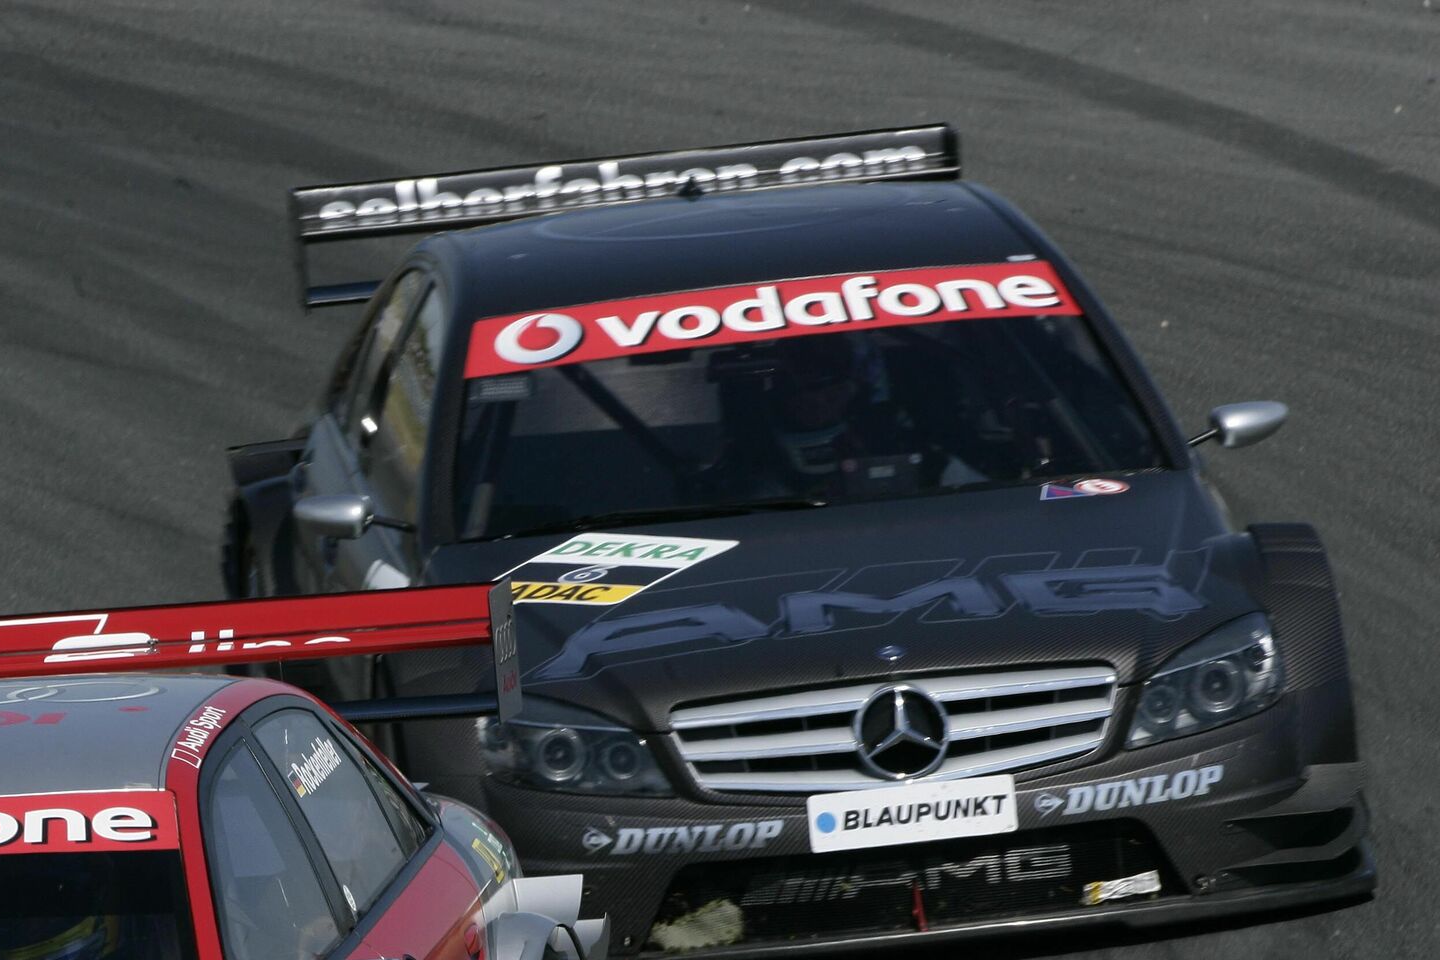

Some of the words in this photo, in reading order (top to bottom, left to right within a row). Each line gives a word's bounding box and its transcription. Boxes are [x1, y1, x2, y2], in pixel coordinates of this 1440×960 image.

[318, 146, 926, 229] selberfahrencom
[597, 273, 1060, 348] vodafone
[551, 540, 709, 561] DEKRA
[512, 584, 612, 601] ADAC
[190, 706, 226, 729] Sport
[177, 725, 209, 752] Audi
[1064, 764, 1224, 816] DUNLOP
[842, 794, 1008, 831] BLAUPUNKT
[611, 820, 784, 855] DUNLOP
